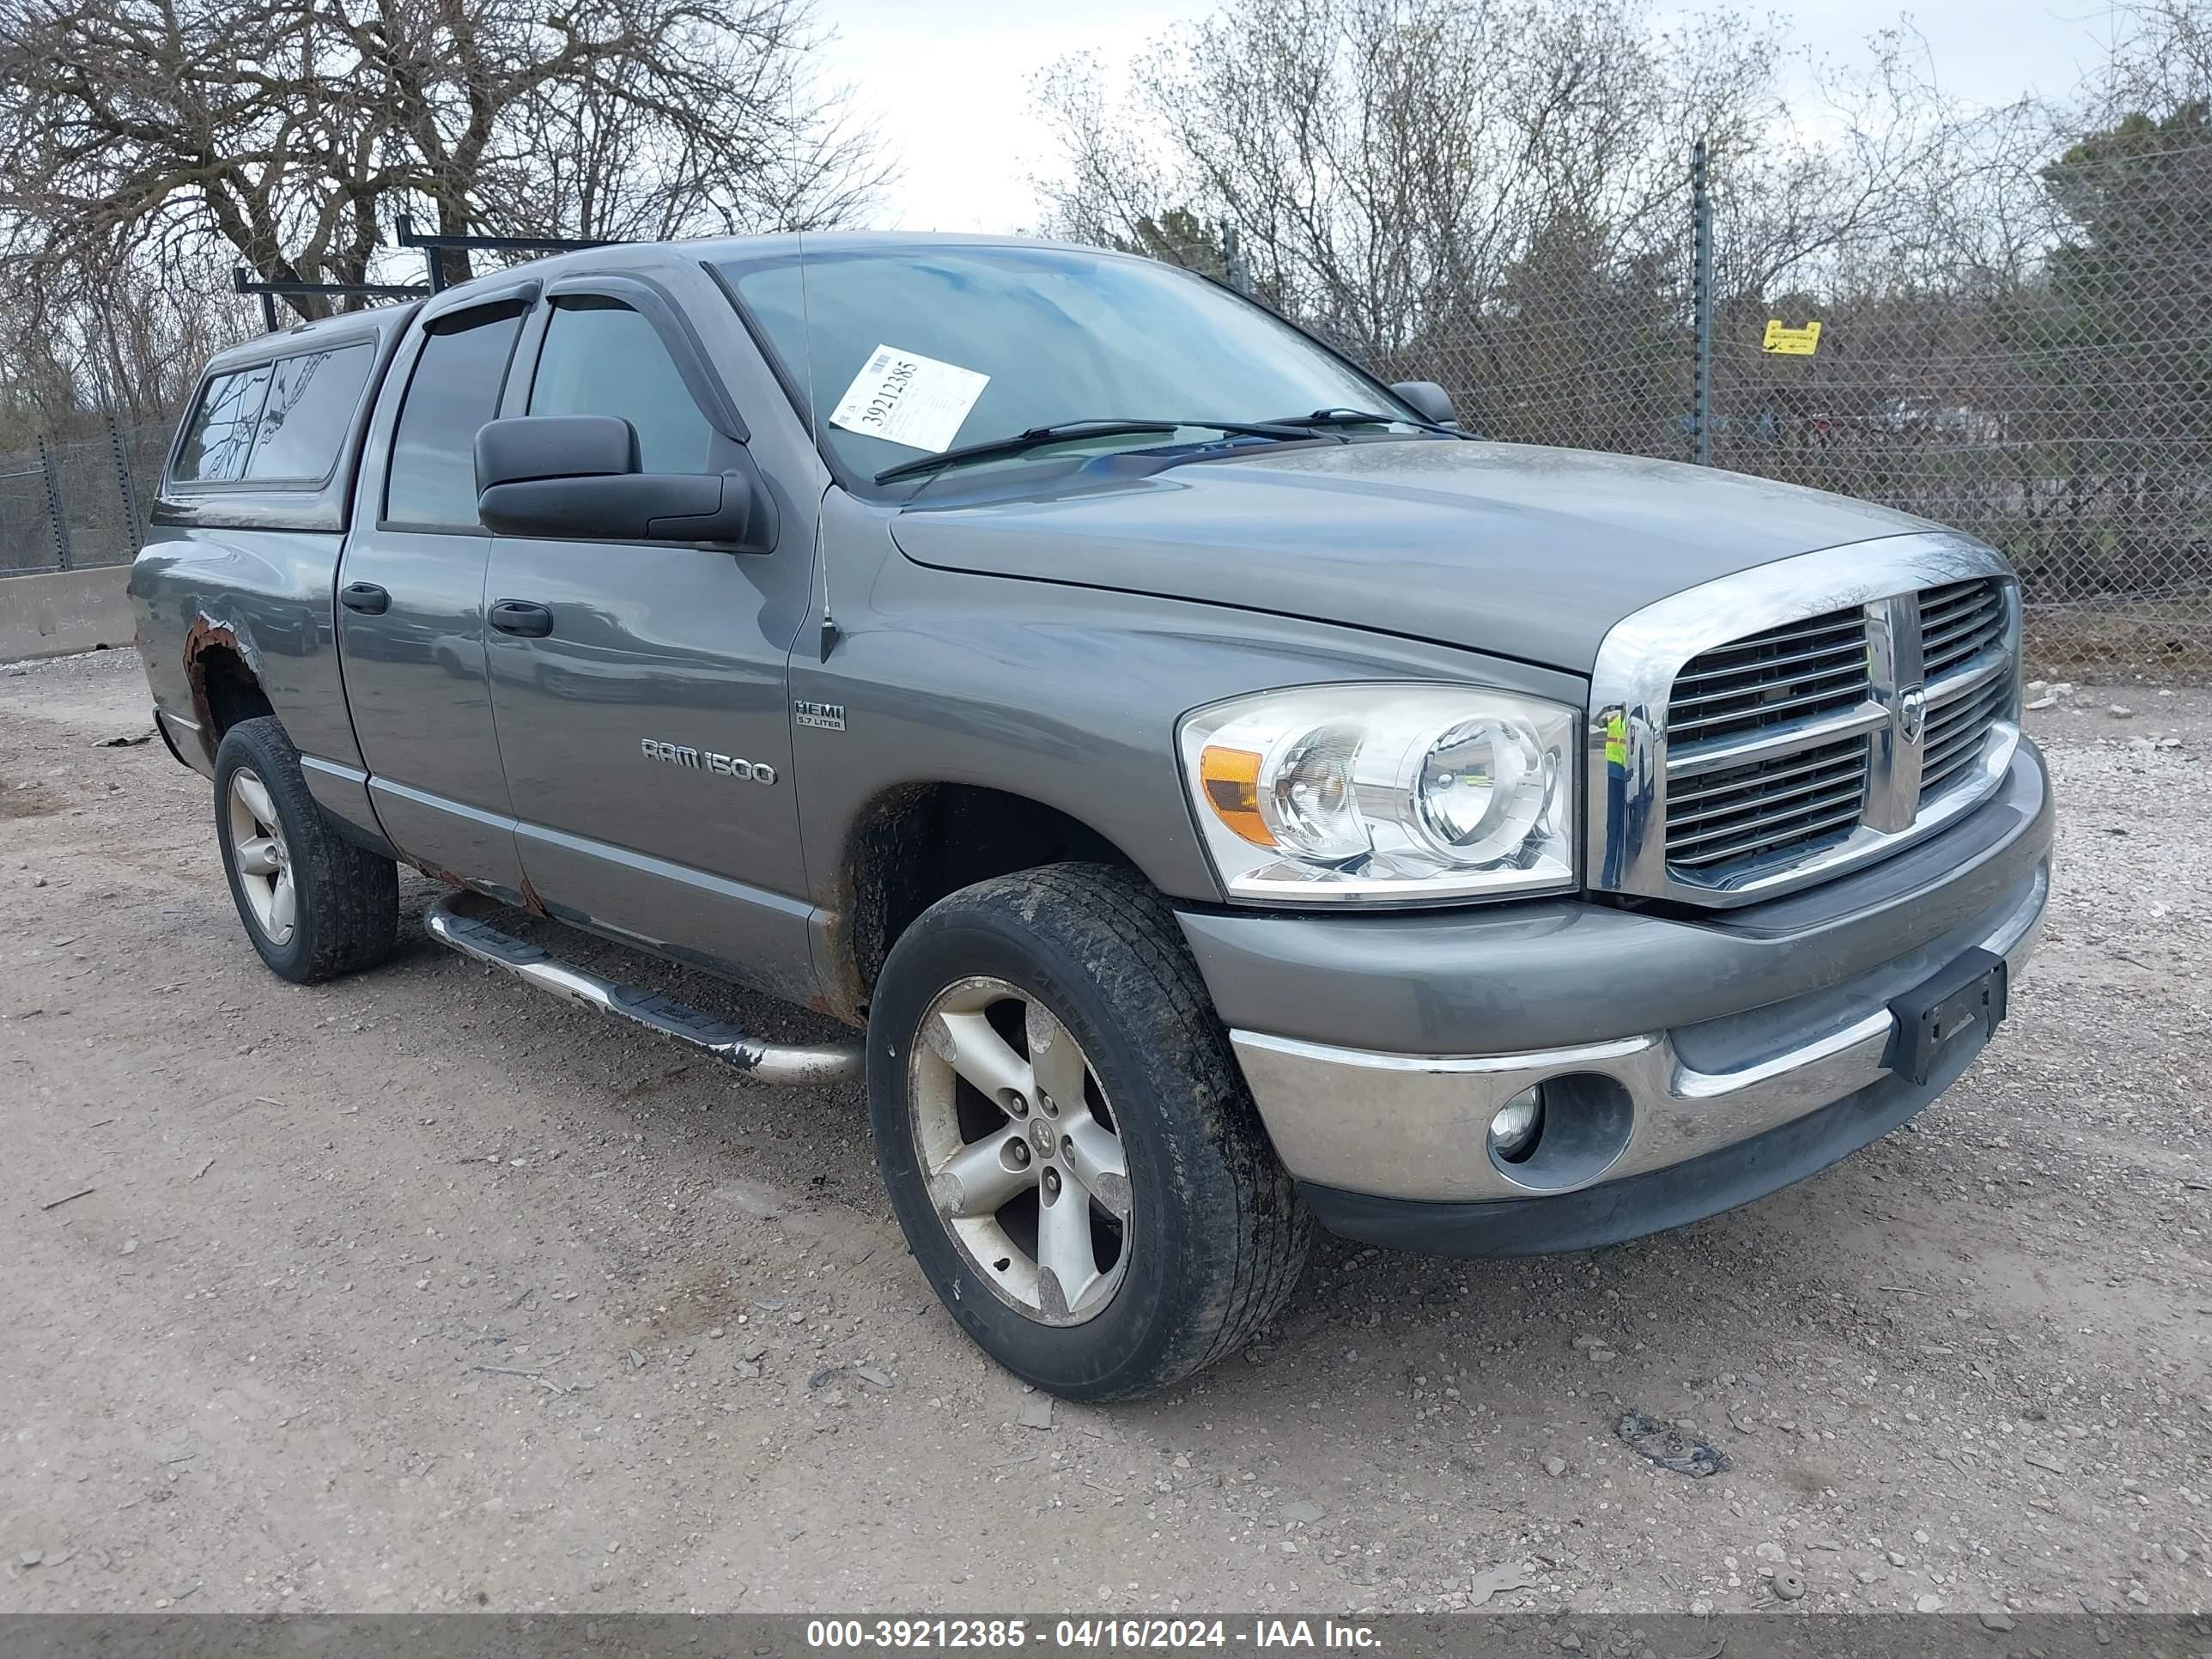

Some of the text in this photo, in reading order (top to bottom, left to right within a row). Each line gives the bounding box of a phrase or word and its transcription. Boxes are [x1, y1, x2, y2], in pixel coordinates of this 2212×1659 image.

[862, 362, 918, 427] 39212385
[795, 701, 843, 720] HEMI
[798, 716, 842, 729] 5.7 LITER
[641, 738, 777, 786] RAM 1500
